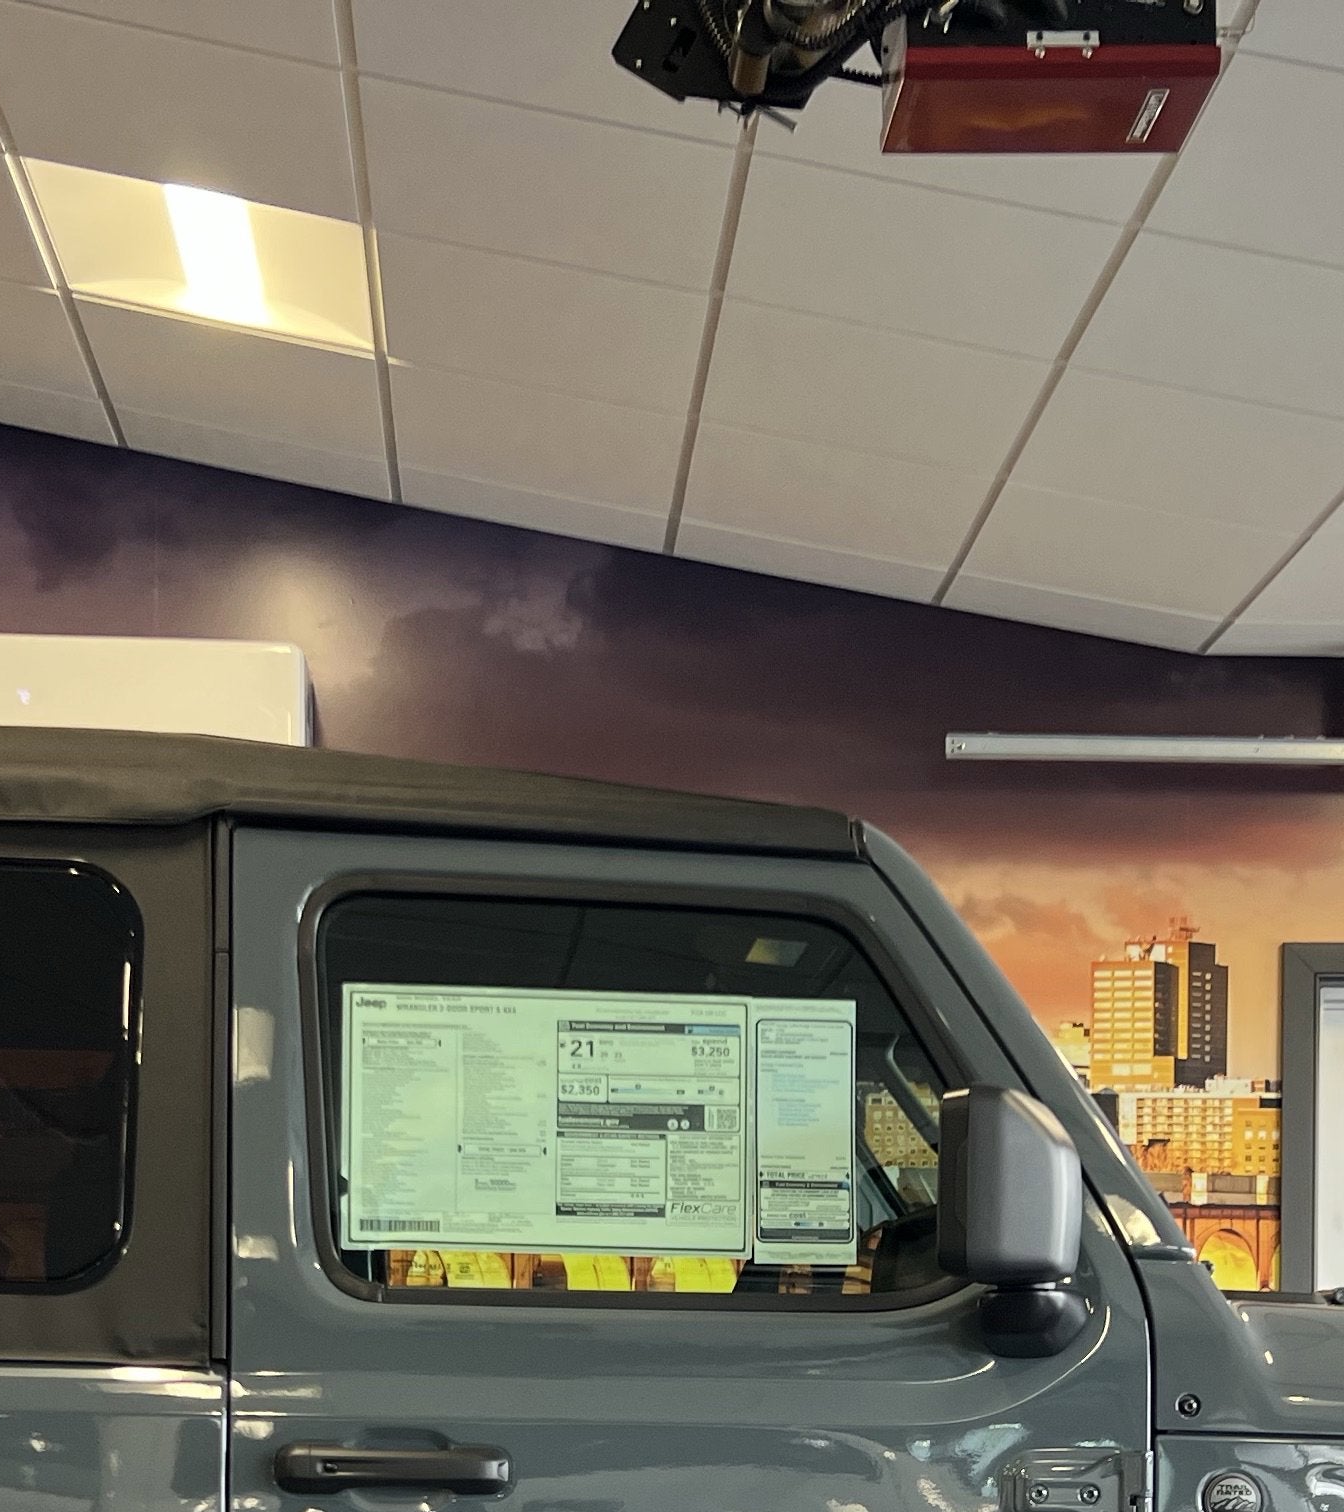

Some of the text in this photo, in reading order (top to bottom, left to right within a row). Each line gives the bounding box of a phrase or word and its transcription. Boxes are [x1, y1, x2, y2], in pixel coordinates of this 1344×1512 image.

[356, 996, 387, 1010] Jeep
[569, 1039, 595, 1057] 21
[691, 1045, 730, 1058] $3,250
[560, 1084, 601, 1097] $2,350
[670, 1202, 737, 1215] FlexCare
